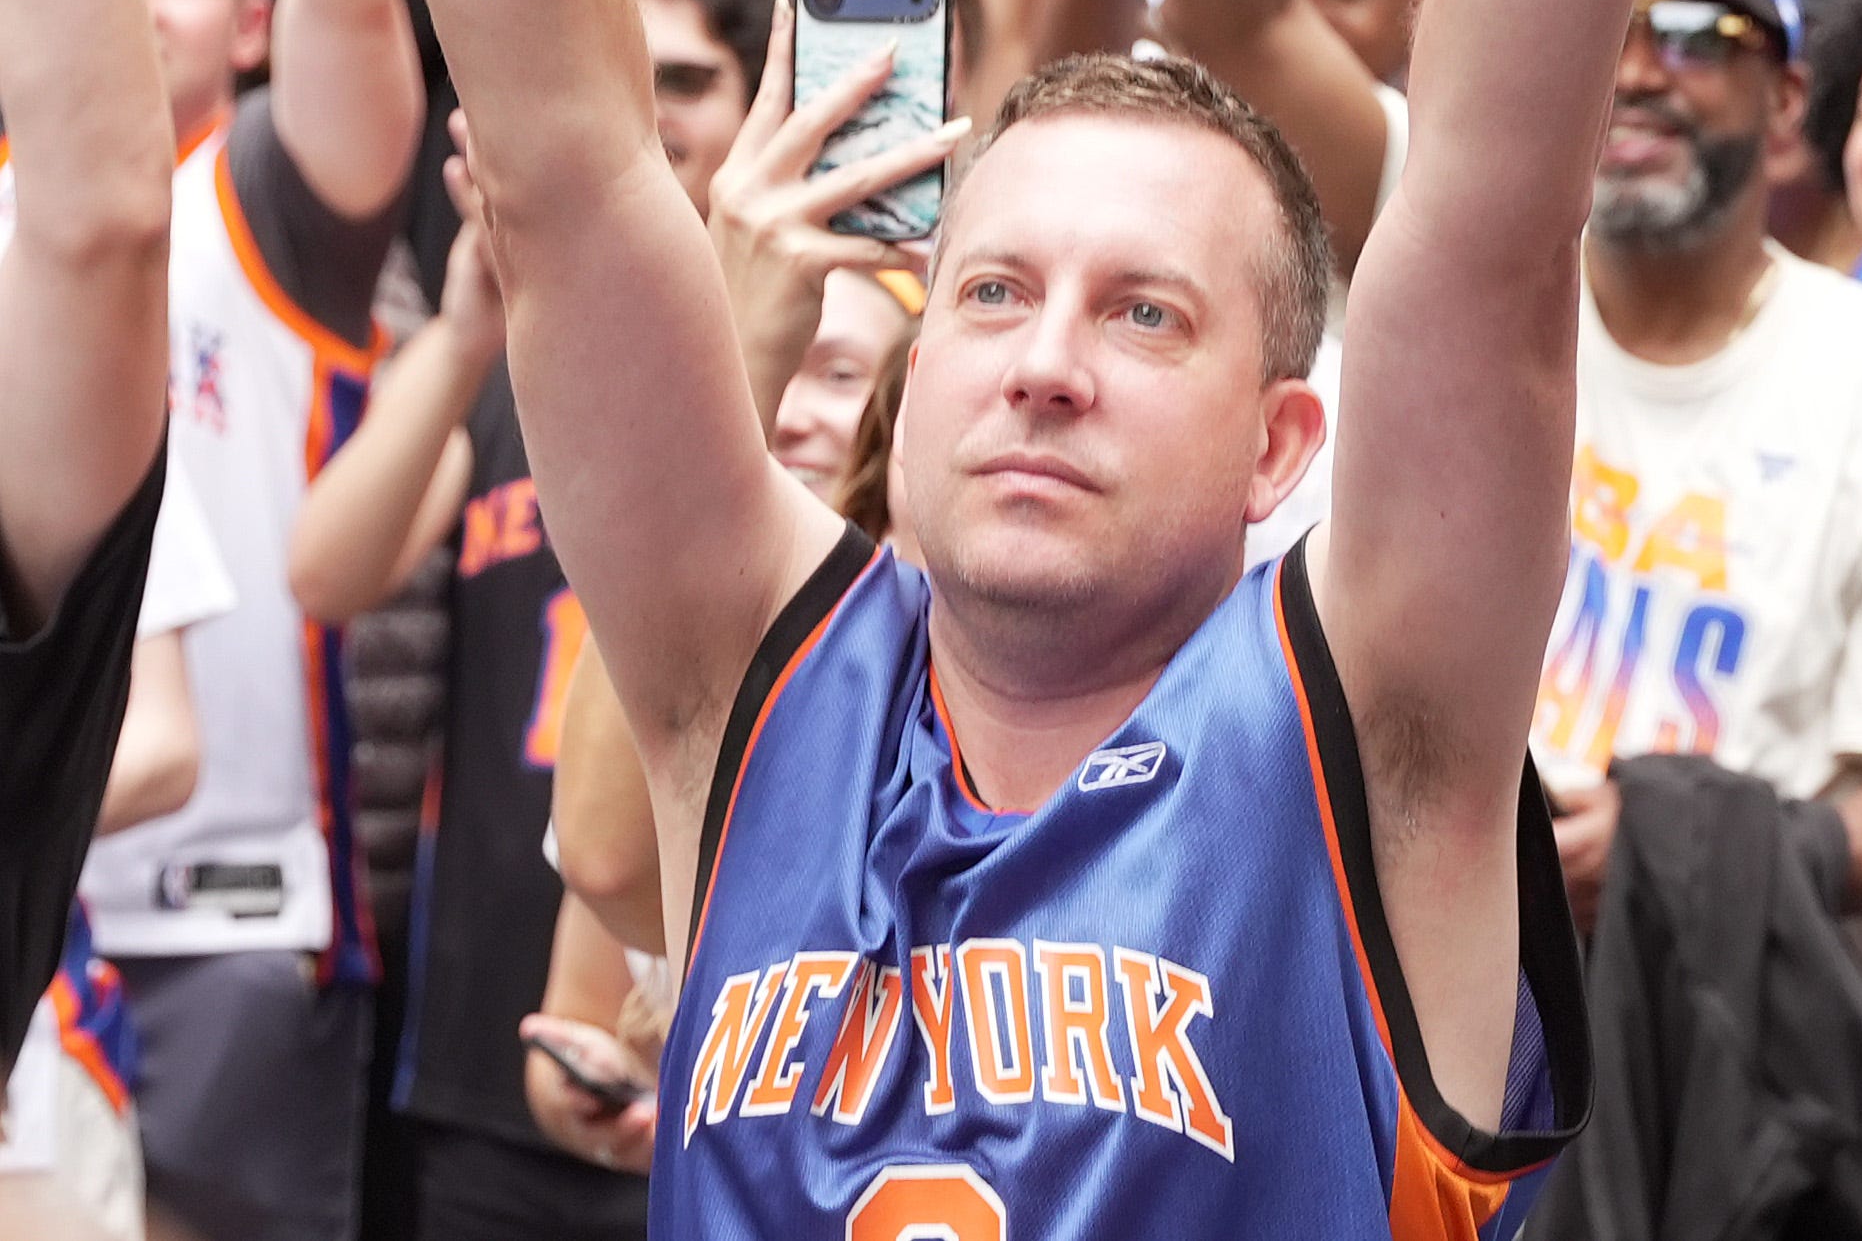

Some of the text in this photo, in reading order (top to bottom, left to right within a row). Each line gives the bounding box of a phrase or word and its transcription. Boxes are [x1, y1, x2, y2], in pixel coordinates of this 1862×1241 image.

[457, 475, 545, 579] NE
[1572, 445, 1728, 591] BA
[683, 936, 1237, 1165] NEW YORK
